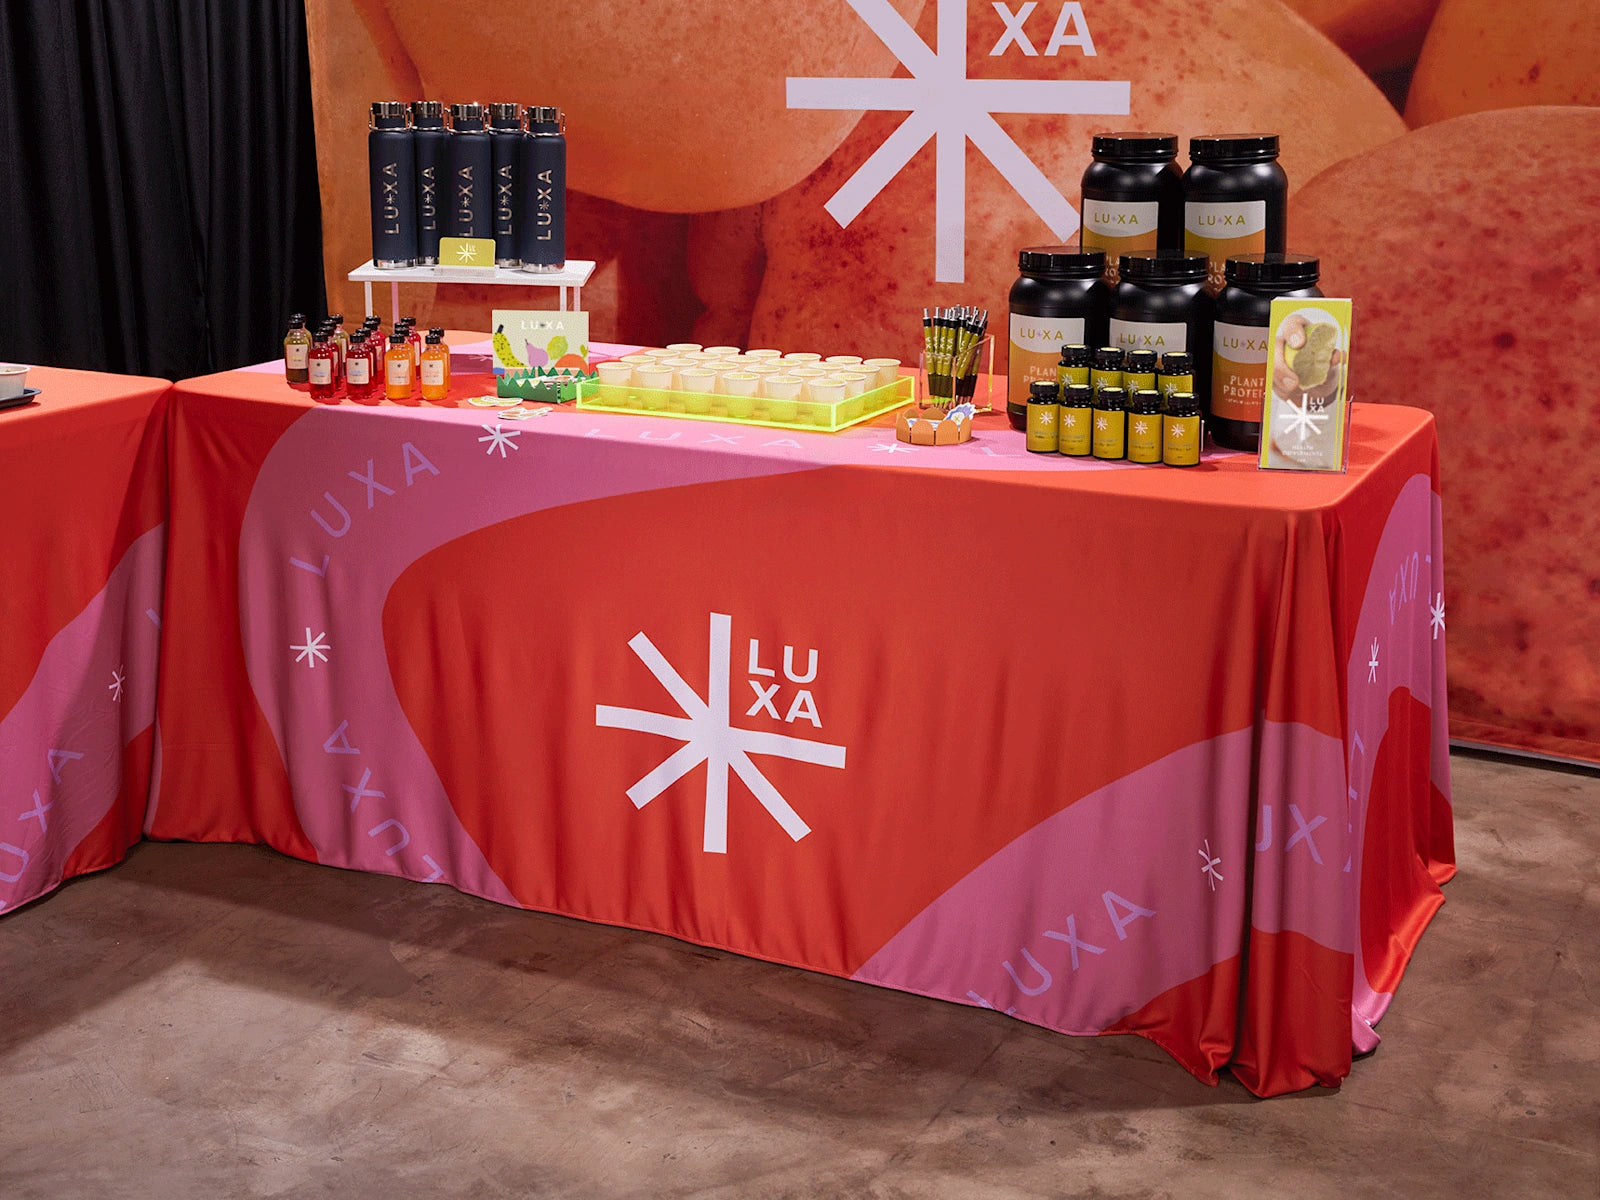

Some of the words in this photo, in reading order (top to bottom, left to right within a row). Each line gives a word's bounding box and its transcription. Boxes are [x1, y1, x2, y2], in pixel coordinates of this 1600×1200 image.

[989, 2, 1098, 56] XA
[1223, 384, 1263, 399] PROTEI
[1230, 374, 1265, 388] PLANT
[1309, 396, 1325, 405] LU
[585, 428, 803, 449] LUXA
[289, 441, 441, 578] LUXA
[748, 638, 819, 684] LU
[745, 680, 823, 728] XA
[0, 748, 84, 911] UXA
